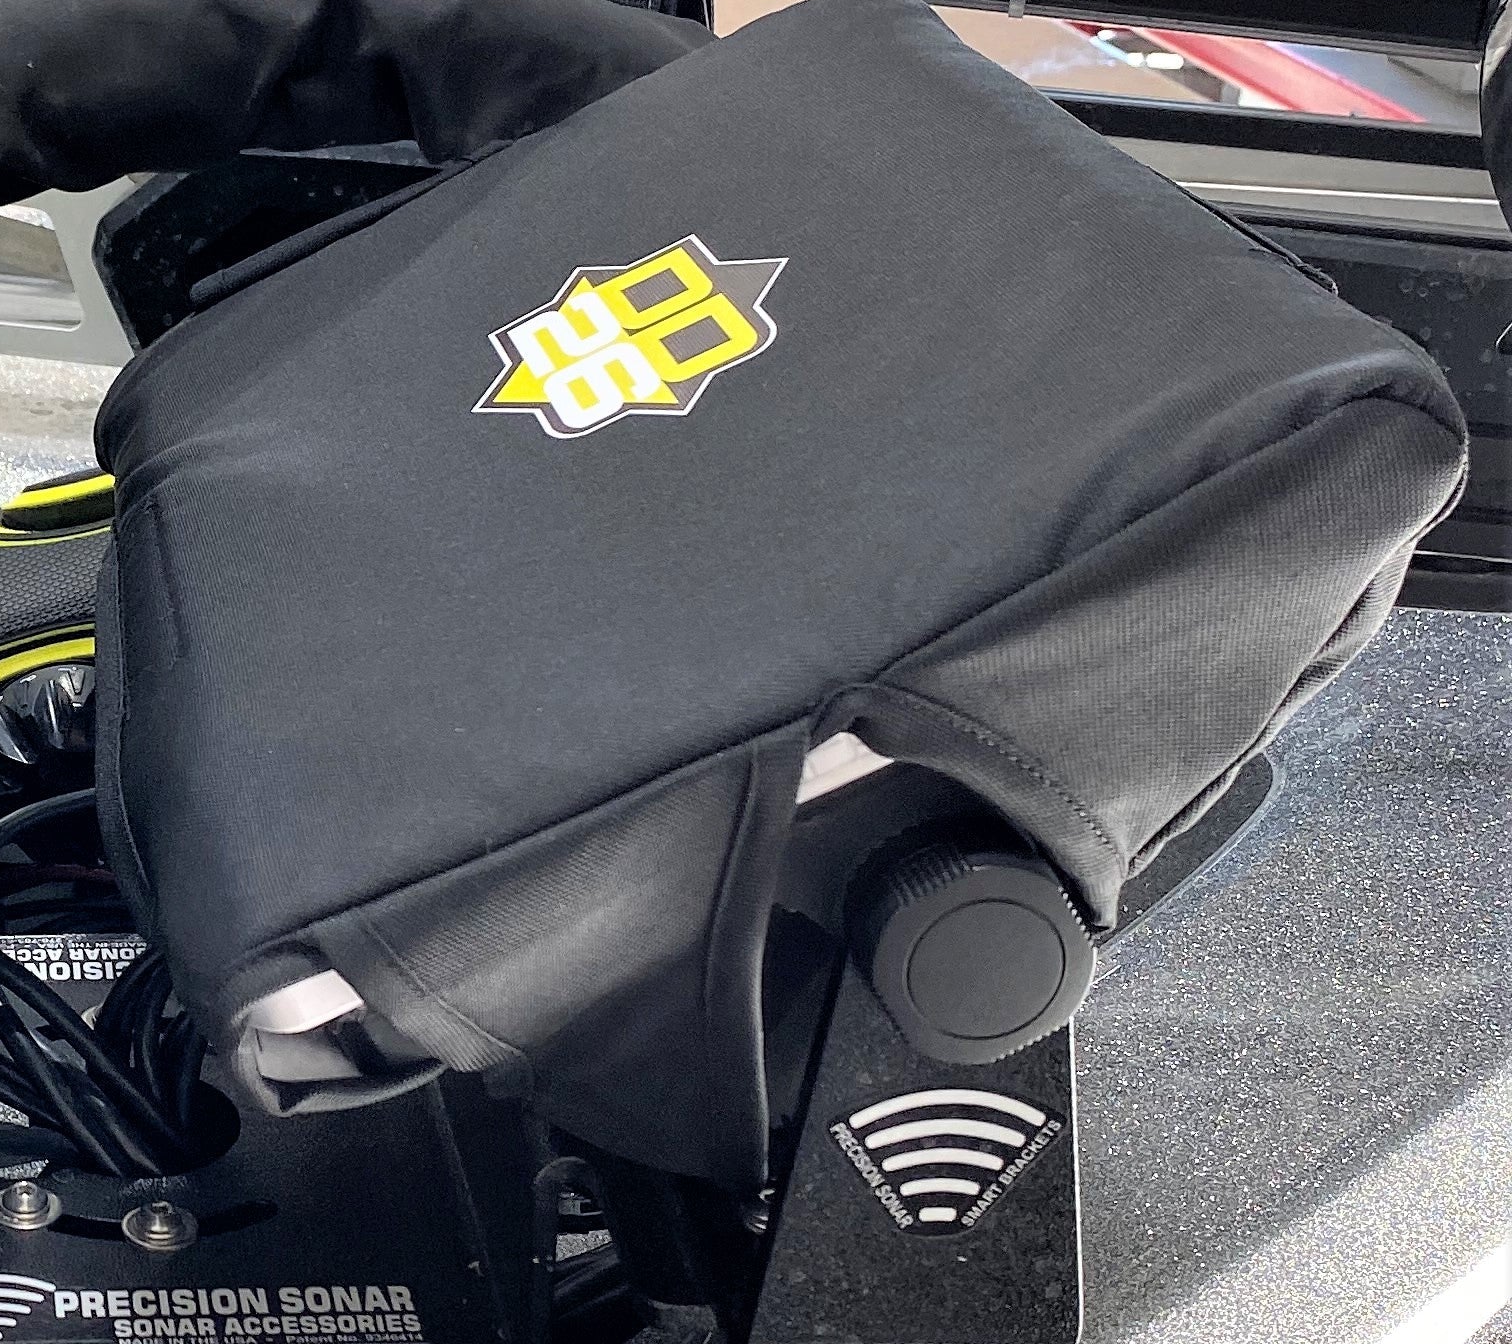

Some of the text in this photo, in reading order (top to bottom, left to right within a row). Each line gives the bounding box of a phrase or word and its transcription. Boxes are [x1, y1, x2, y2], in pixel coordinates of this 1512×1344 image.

[829, 1122, 913, 1230] PRECISION SONAR
[960, 1119, 1062, 1227] SMART BRACKETS
[54, 1285, 415, 1318] PRECISION SONAR
[114, 1313, 422, 1338] SONAR ACCESSORIES
[191, 1337, 219, 1344] THE
[224, 1336, 255, 1344] USA
[286, 1335, 333, 1344] Patent
